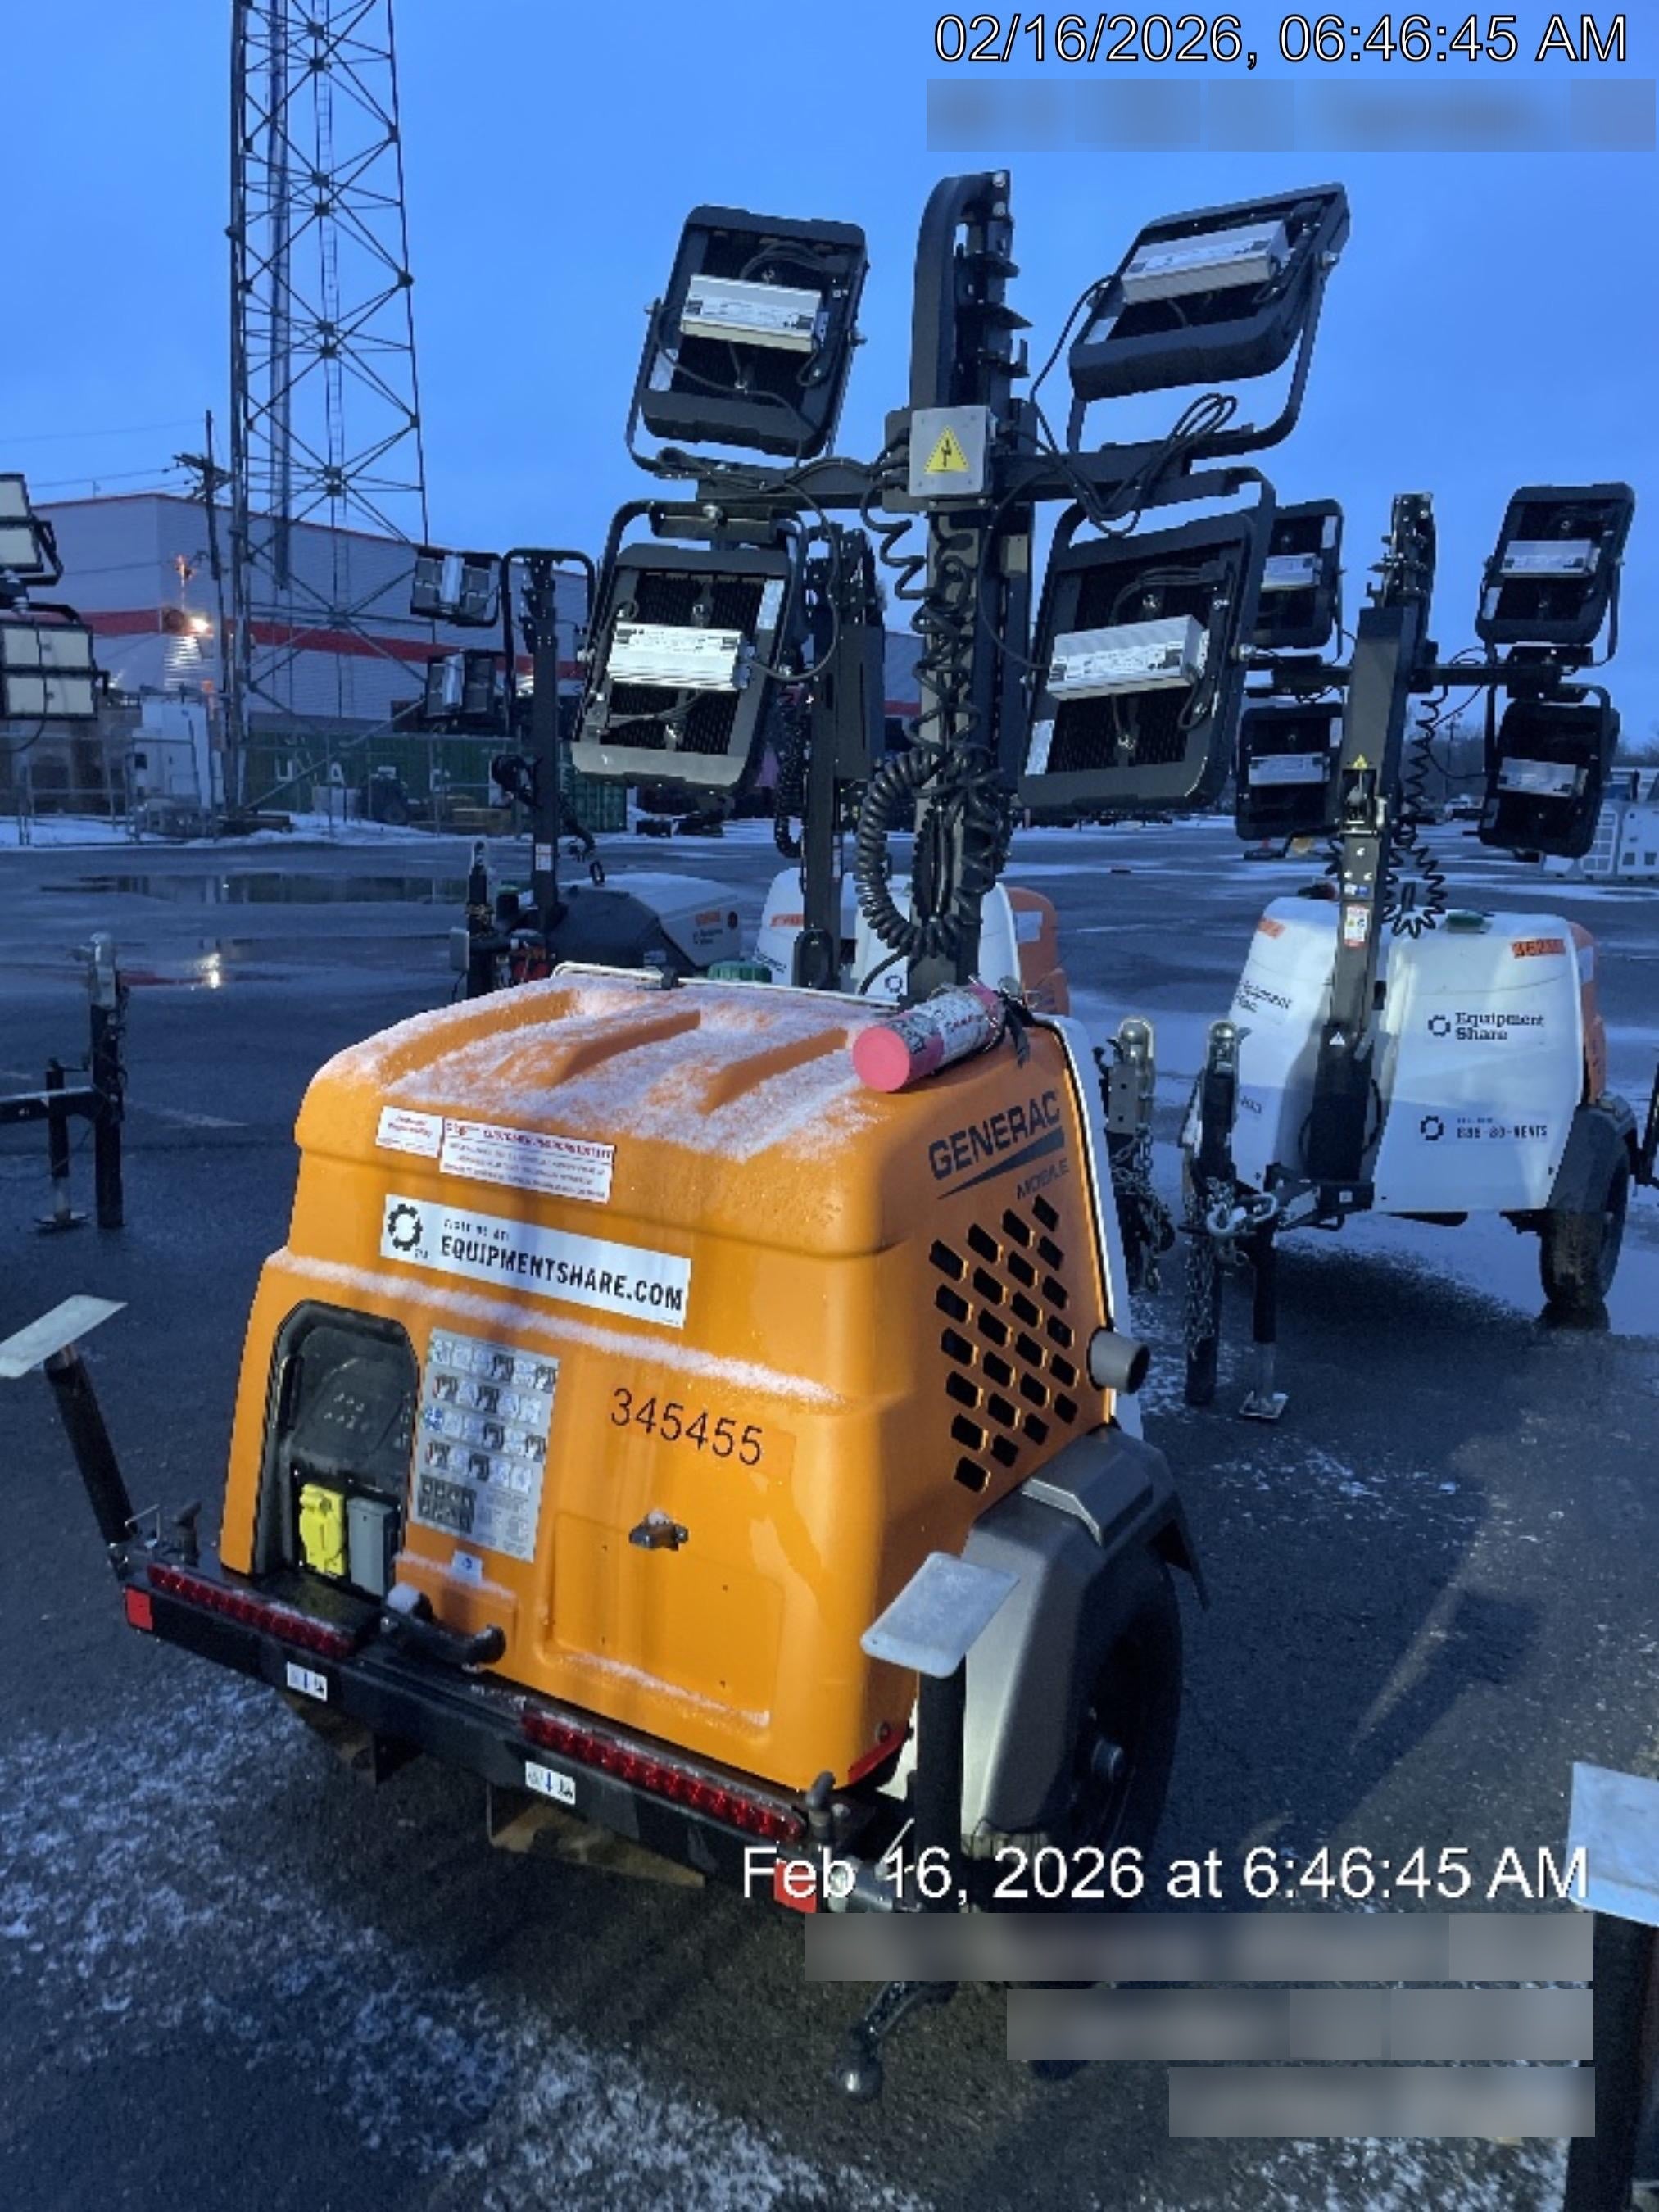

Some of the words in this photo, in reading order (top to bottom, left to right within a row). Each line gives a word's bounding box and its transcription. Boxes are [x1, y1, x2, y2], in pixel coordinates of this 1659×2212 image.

[1455, 1013, 1544, 1027] Equipment
[1456, 1027, 1507, 1040] Share
[928, 1090, 1060, 1180] GENERAC
[441, 1235, 683, 1312] EQUIPMENTSHARE.COM
[610, 1388, 763, 1465] 345455
